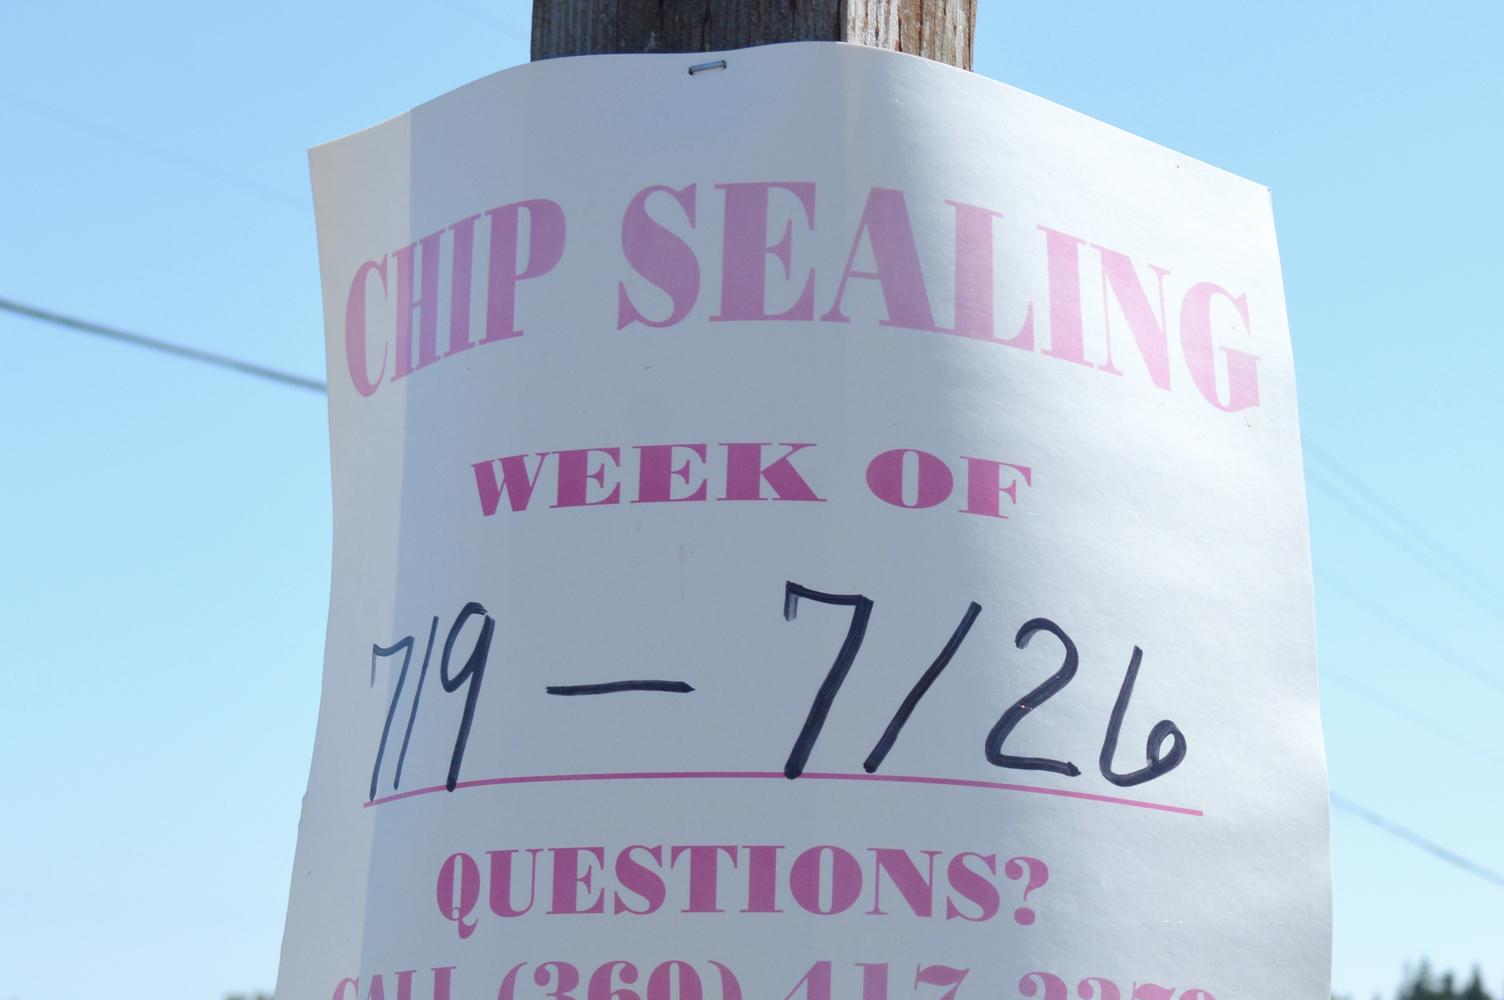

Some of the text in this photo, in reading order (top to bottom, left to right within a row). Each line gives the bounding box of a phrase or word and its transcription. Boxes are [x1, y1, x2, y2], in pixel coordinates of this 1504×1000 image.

[344, 181, 1262, 413] CHIP SEALING
[471, 442, 1034, 520] WEEK OF
[369, 600, 496, 801] 7/9
[783, 580, 1187, 787] 7/26
[436, 843, 1050, 939] QUESTIONS?
